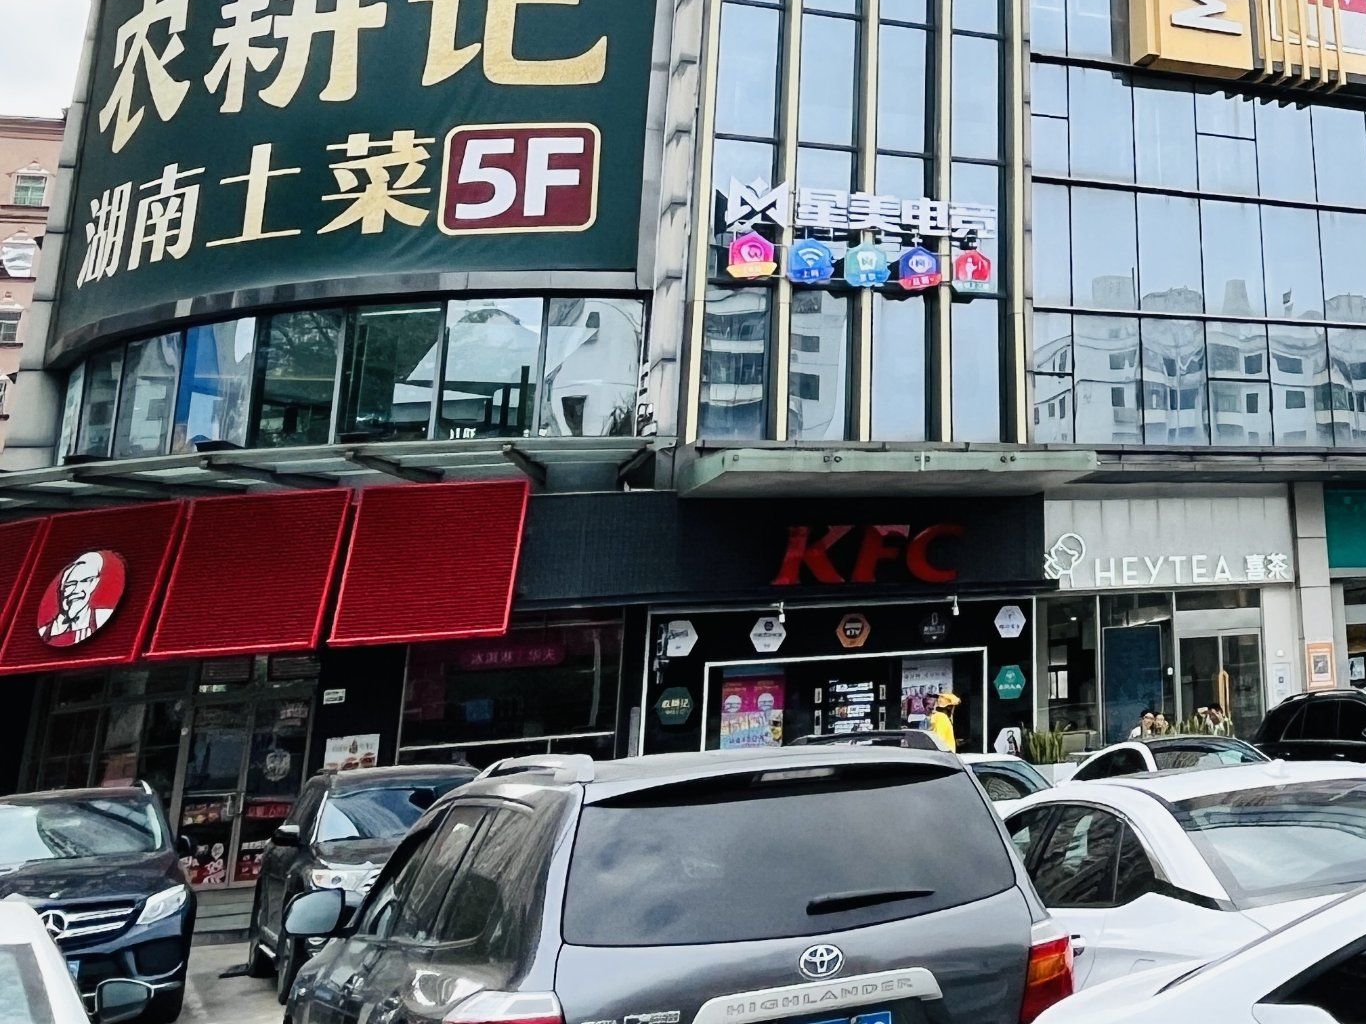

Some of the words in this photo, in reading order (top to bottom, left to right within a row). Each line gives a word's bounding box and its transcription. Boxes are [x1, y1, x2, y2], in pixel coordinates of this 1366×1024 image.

[76, 129, 436, 289] 湖南土菜
[453, 137, 585, 221] 5F
[770, 523, 966, 586] KFC
[1094, 554, 1233, 587] HEYTEA
[1245, 552, 1290, 580] 喜茶
[726, 977, 914, 1016] HIGHLANDER
